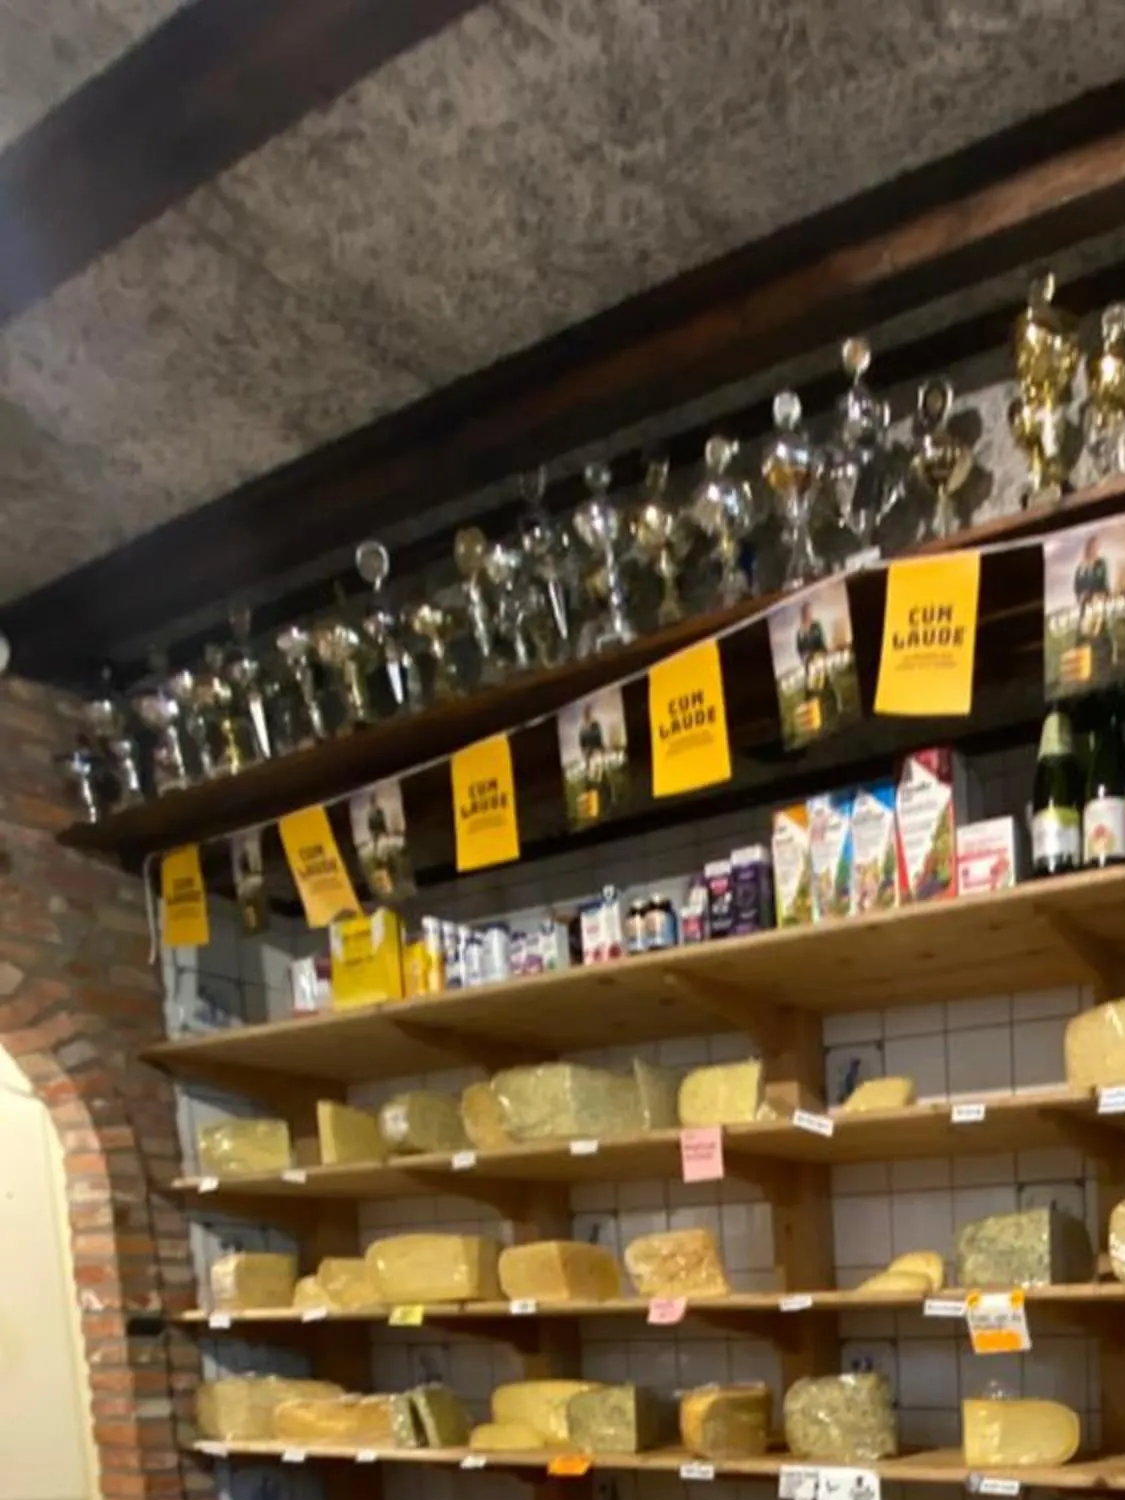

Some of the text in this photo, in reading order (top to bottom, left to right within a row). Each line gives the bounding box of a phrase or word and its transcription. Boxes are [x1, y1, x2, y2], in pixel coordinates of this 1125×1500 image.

[908, 604, 954, 626] CUM
[893, 627, 965, 650] LAUDE
[668, 689, 705, 716] CUM
[659, 705, 716, 740] LAUDE
